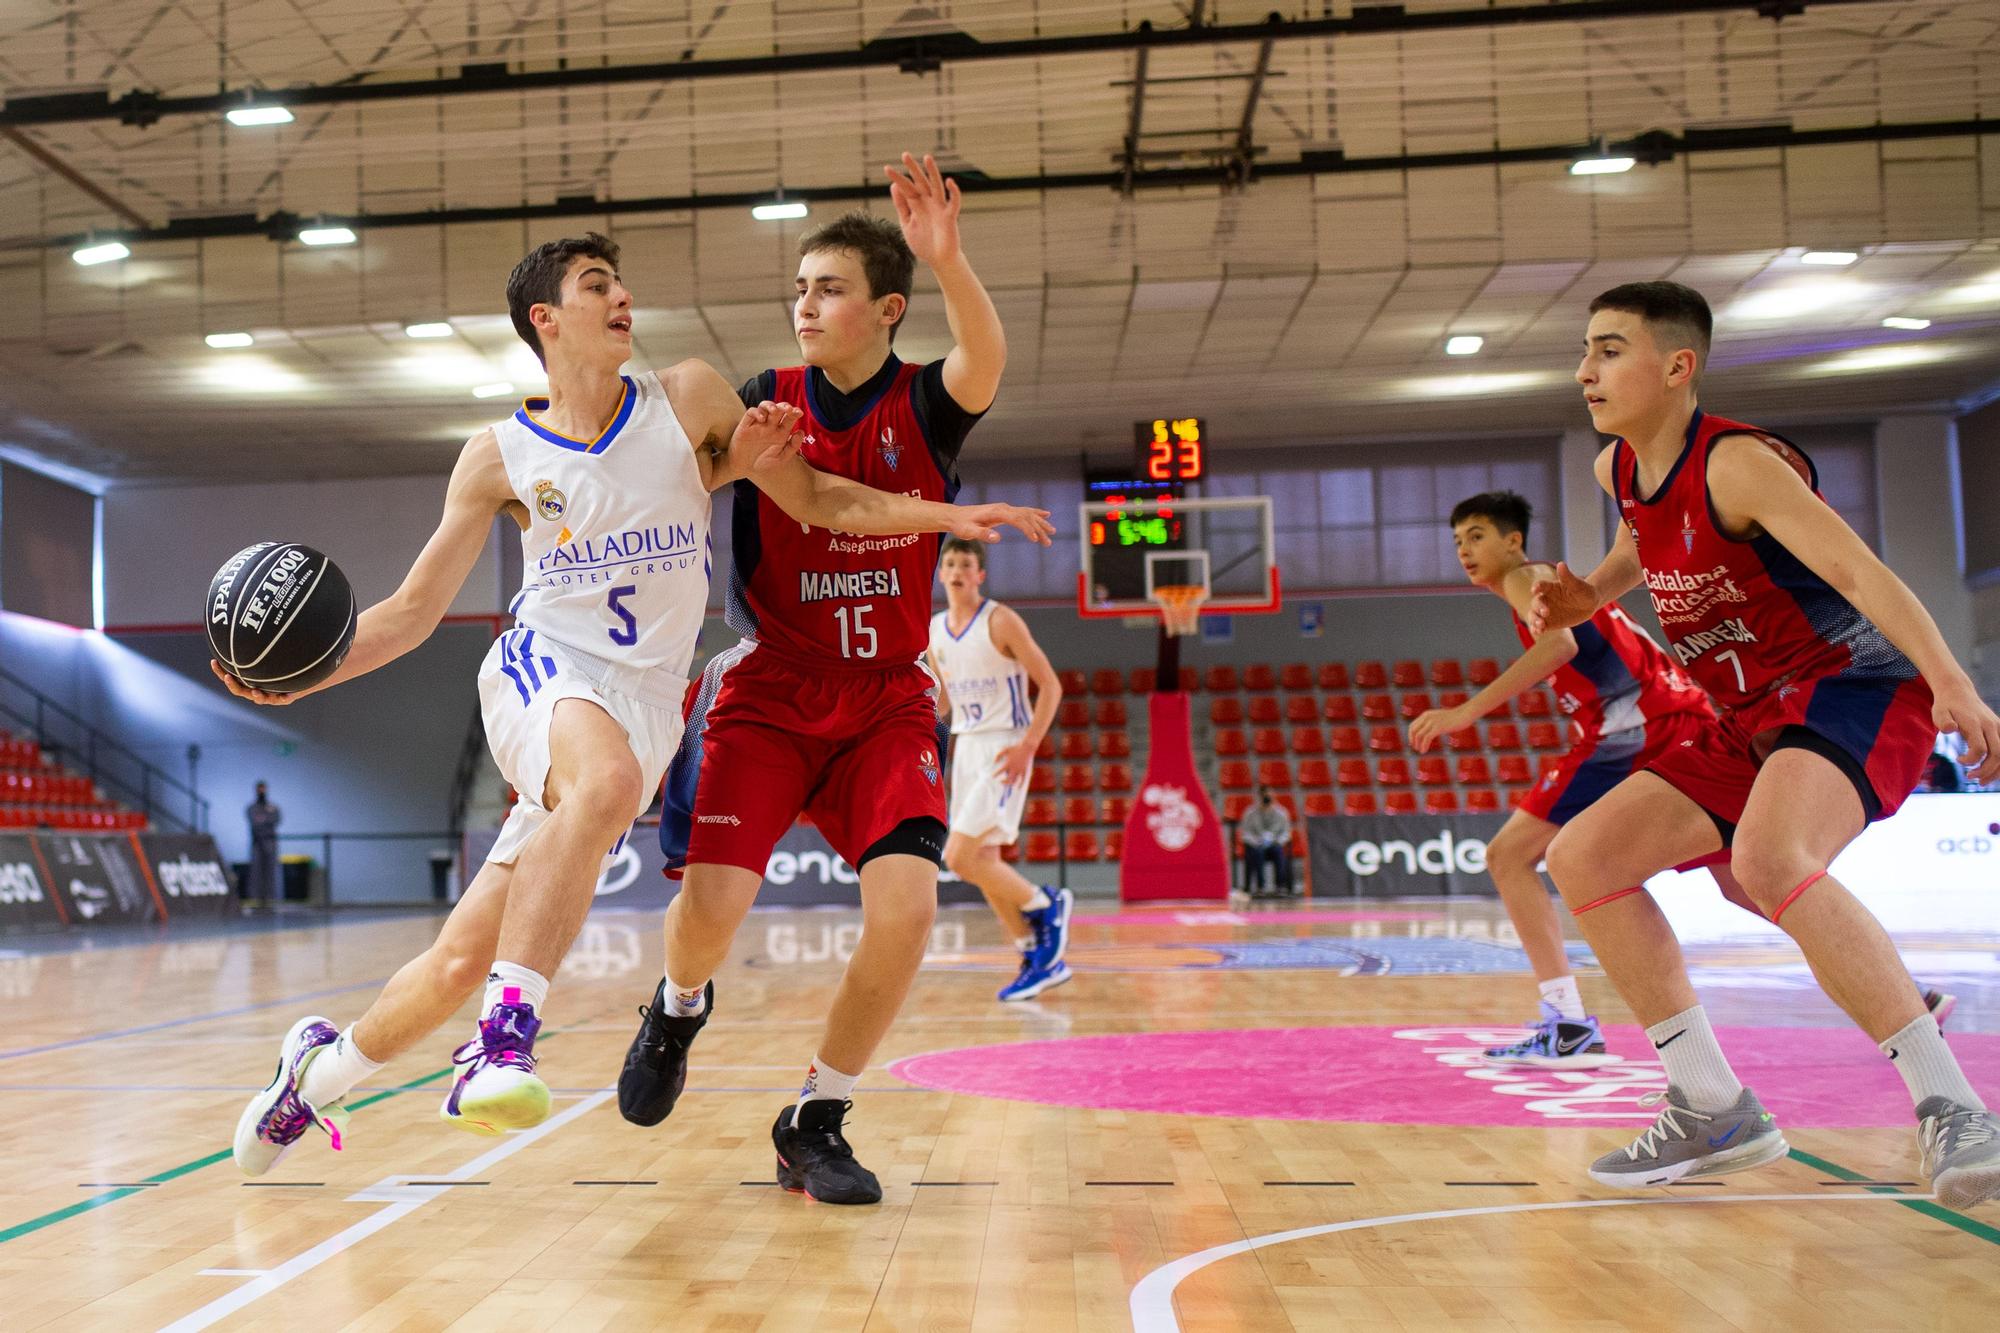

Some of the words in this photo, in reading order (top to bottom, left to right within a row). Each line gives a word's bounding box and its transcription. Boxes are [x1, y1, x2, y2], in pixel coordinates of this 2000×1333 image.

[1149, 441, 1201, 478] 23
[828, 533, 919, 554] Assegurances
[242, 550, 305, 630] TF-1000
[272, 573, 297, 609] LEGACY
[801, 568, 901, 602] MANRESA
[1643, 565, 1729, 591] Catalana
[607, 584, 638, 646] 5
[834, 604, 878, 659] 15
[1714, 649, 1747, 693] 7
[1936, 836, 1992, 853] acb
